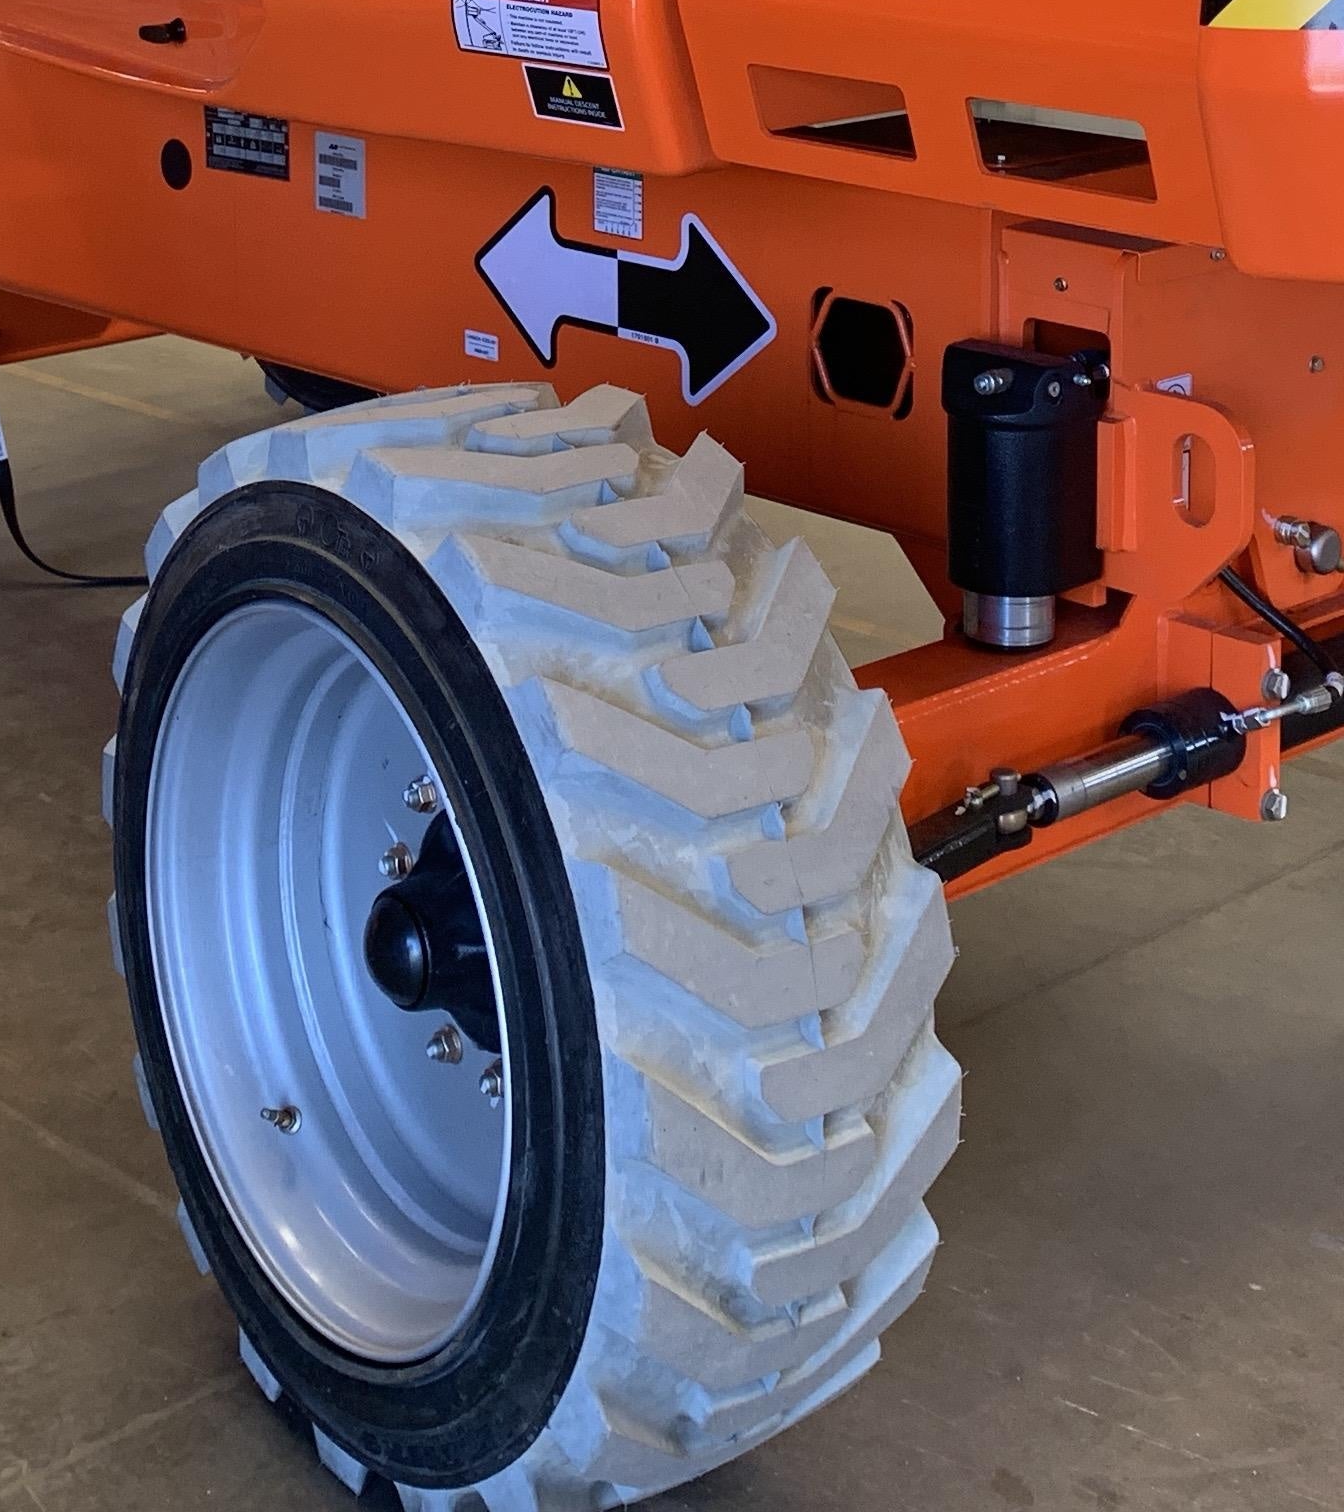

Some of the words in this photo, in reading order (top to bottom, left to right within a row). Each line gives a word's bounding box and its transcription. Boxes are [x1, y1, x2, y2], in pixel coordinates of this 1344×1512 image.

[546, 102, 588, 116] INSTRUCTIONS
[548, 95, 574, 107] MANUAL
[574, 99, 600, 111] DESCENT
